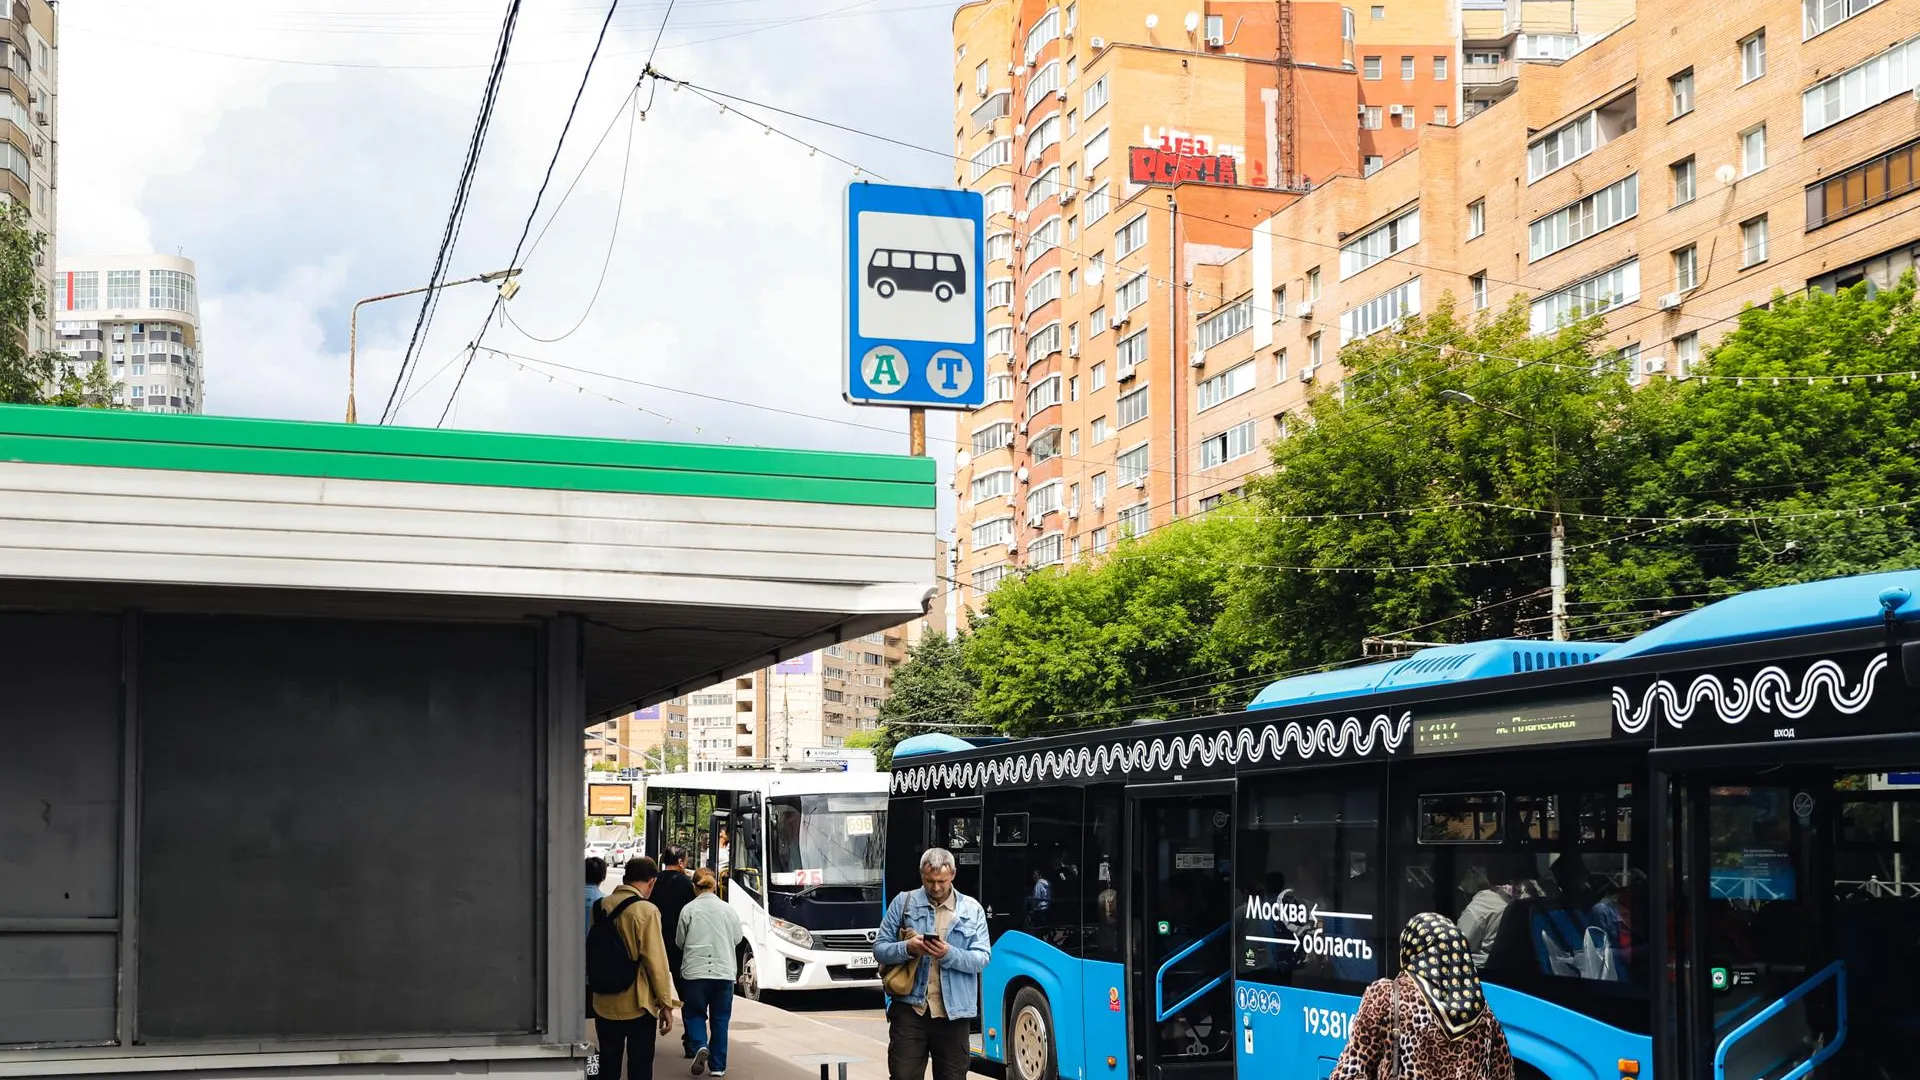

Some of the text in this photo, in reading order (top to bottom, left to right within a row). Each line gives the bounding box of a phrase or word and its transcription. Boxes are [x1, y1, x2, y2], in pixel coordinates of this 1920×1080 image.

[869, 353, 963, 390] А Т
[1773, 728, 1795, 738] ВХОД
[1246, 894, 1307, 924] Москва
[1303, 928, 1373, 960] область
